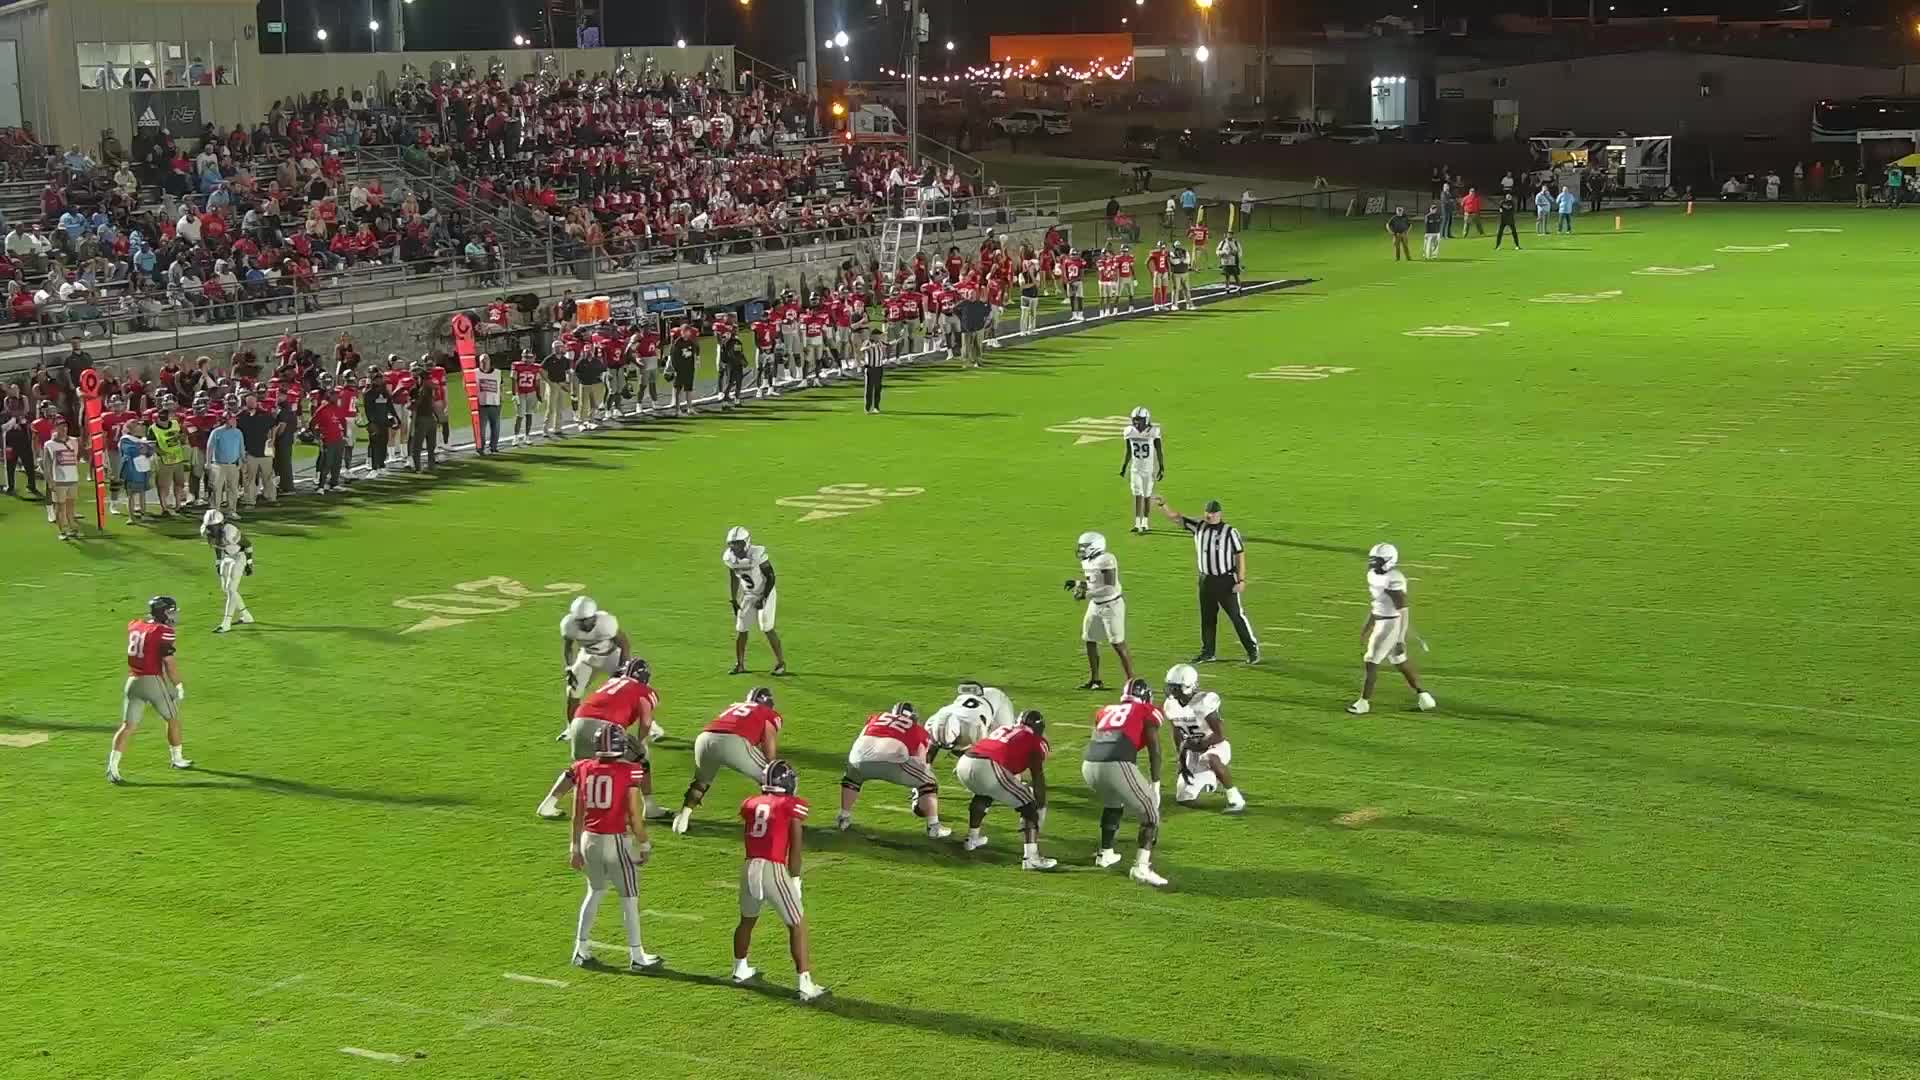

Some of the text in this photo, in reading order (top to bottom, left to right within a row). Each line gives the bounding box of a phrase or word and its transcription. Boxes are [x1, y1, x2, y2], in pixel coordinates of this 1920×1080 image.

[518, 372, 535, 388] 23
[1133, 442, 1150, 459] 29
[128, 630, 145, 658] 81
[719, 702, 760, 718] 75
[1096, 703, 1133, 729] 78
[873, 711, 913, 734] 52
[585, 774, 613, 810] 10
[750, 803, 771, 838] 8
